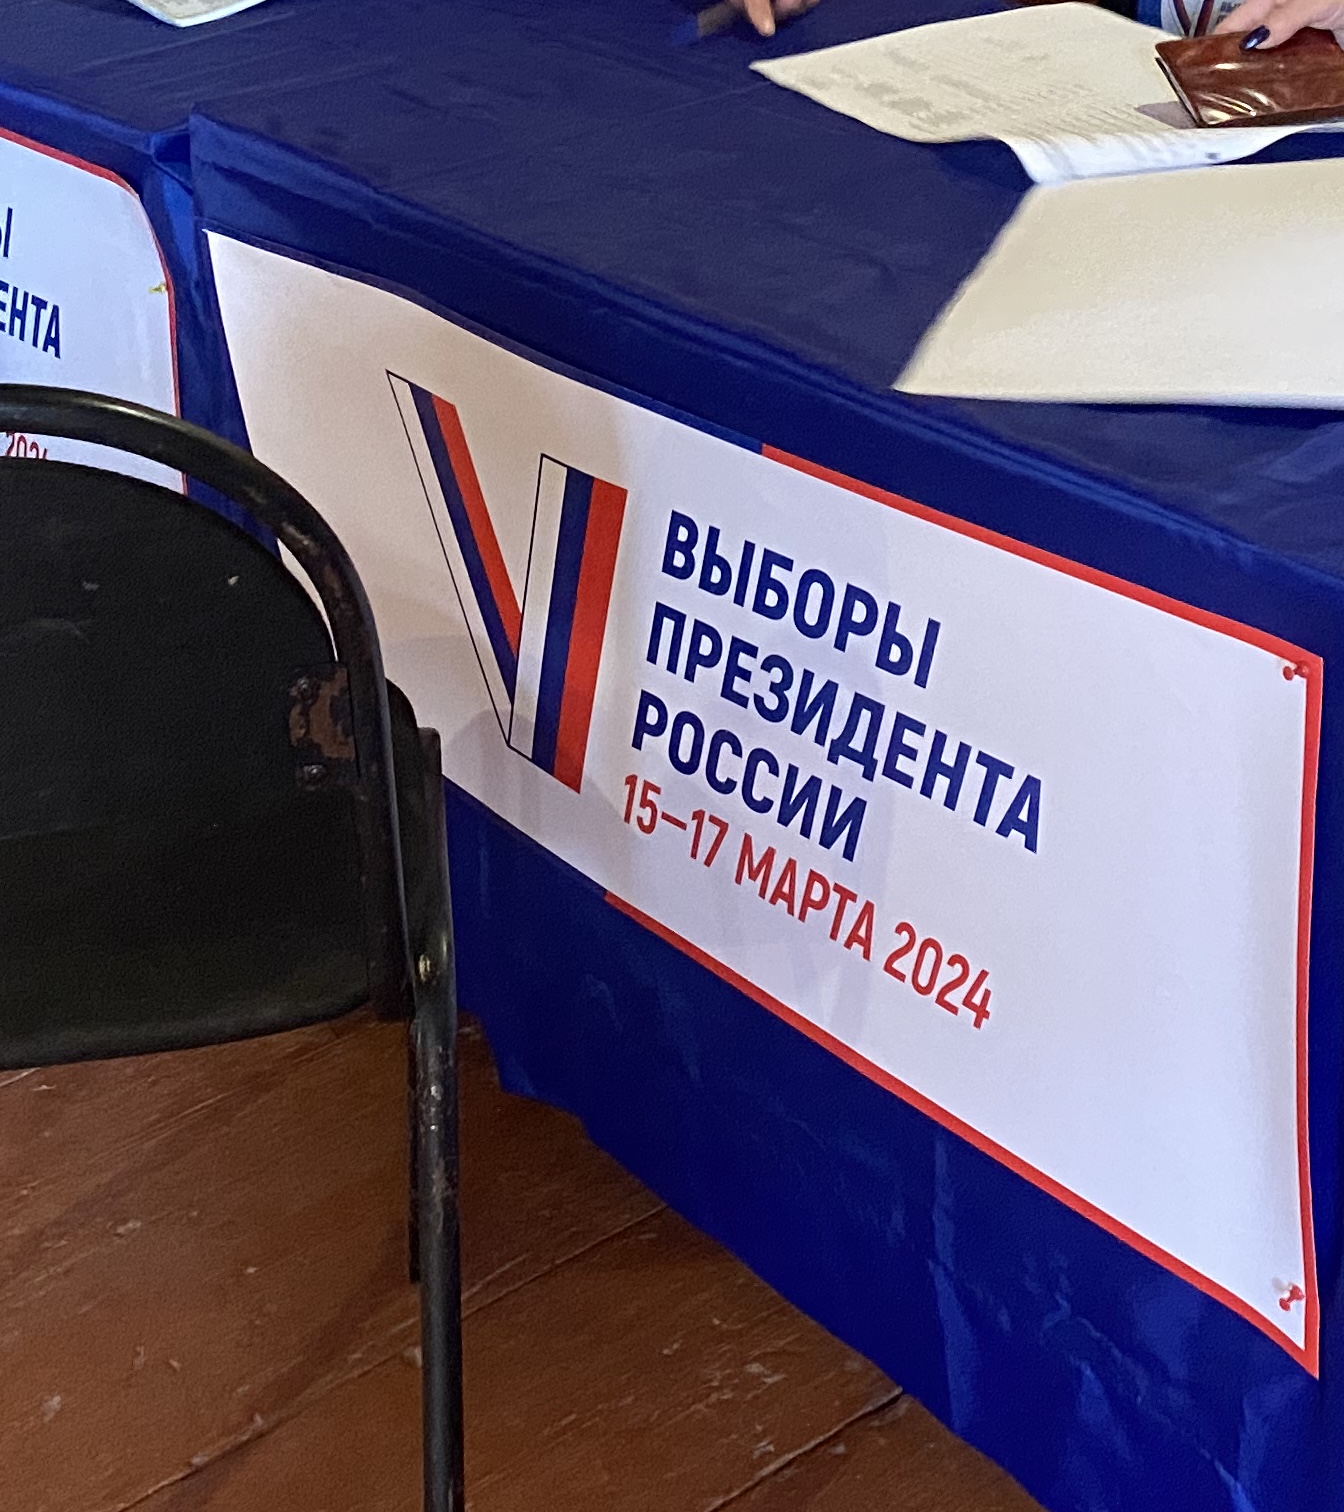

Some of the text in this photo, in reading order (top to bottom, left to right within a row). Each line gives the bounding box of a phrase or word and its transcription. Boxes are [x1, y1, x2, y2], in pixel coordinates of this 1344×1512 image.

[660, 509, 941, 688] ВЫБОРЫ
[630, 691, 867, 861] РОССИИ
[646, 602, 1042, 853] ПРЕЗИДЕНТА
[734, 847, 875, 961] МАРТА
[882, 922, 993, 1029] 2024
